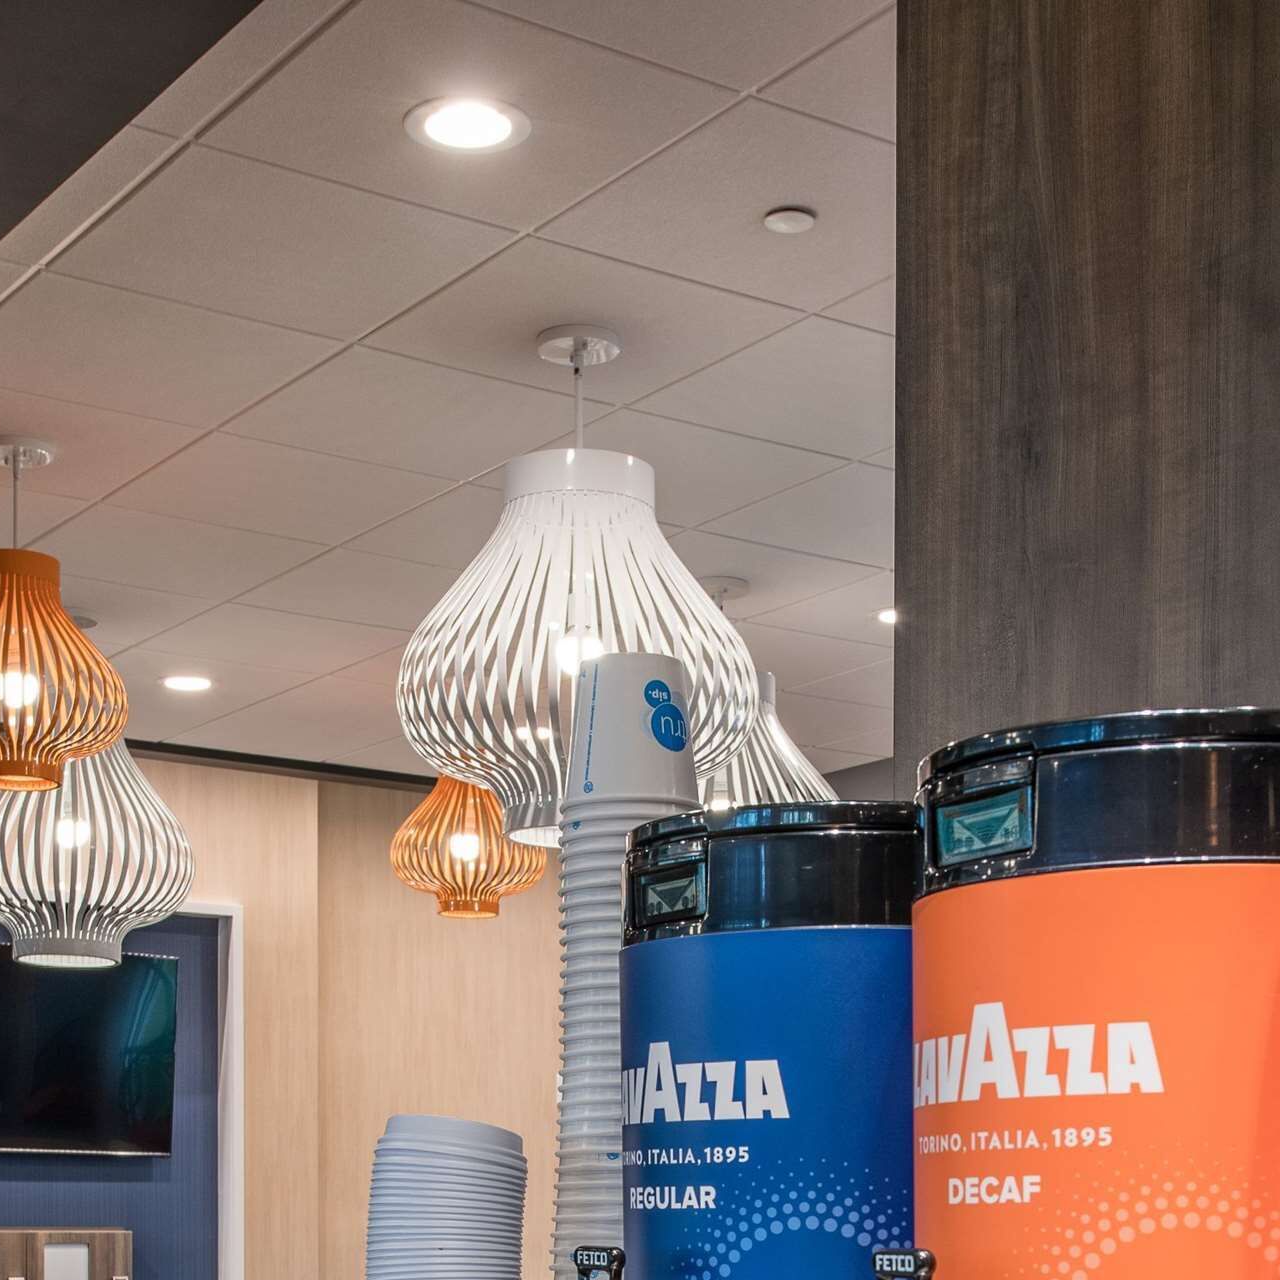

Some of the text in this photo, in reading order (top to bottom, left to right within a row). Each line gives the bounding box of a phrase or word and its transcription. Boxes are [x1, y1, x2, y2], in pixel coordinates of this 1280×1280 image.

[913, 1001, 1165, 1109] LAVAZZA
[621, 1041, 790, 1126] AVAZZA
[919, 1126, 1113, 1155] TORINO, ITALIA, 1895
[647, 1147, 702, 1166] ITALIA,
[703, 1146, 750, 1163] 1895
[630, 1185, 717, 1210] REGULAR
[947, 1175, 1041, 1205] DECAF
[577, 1250, 608, 1266] FETCO
[875, 1254, 915, 1272] FETCO
